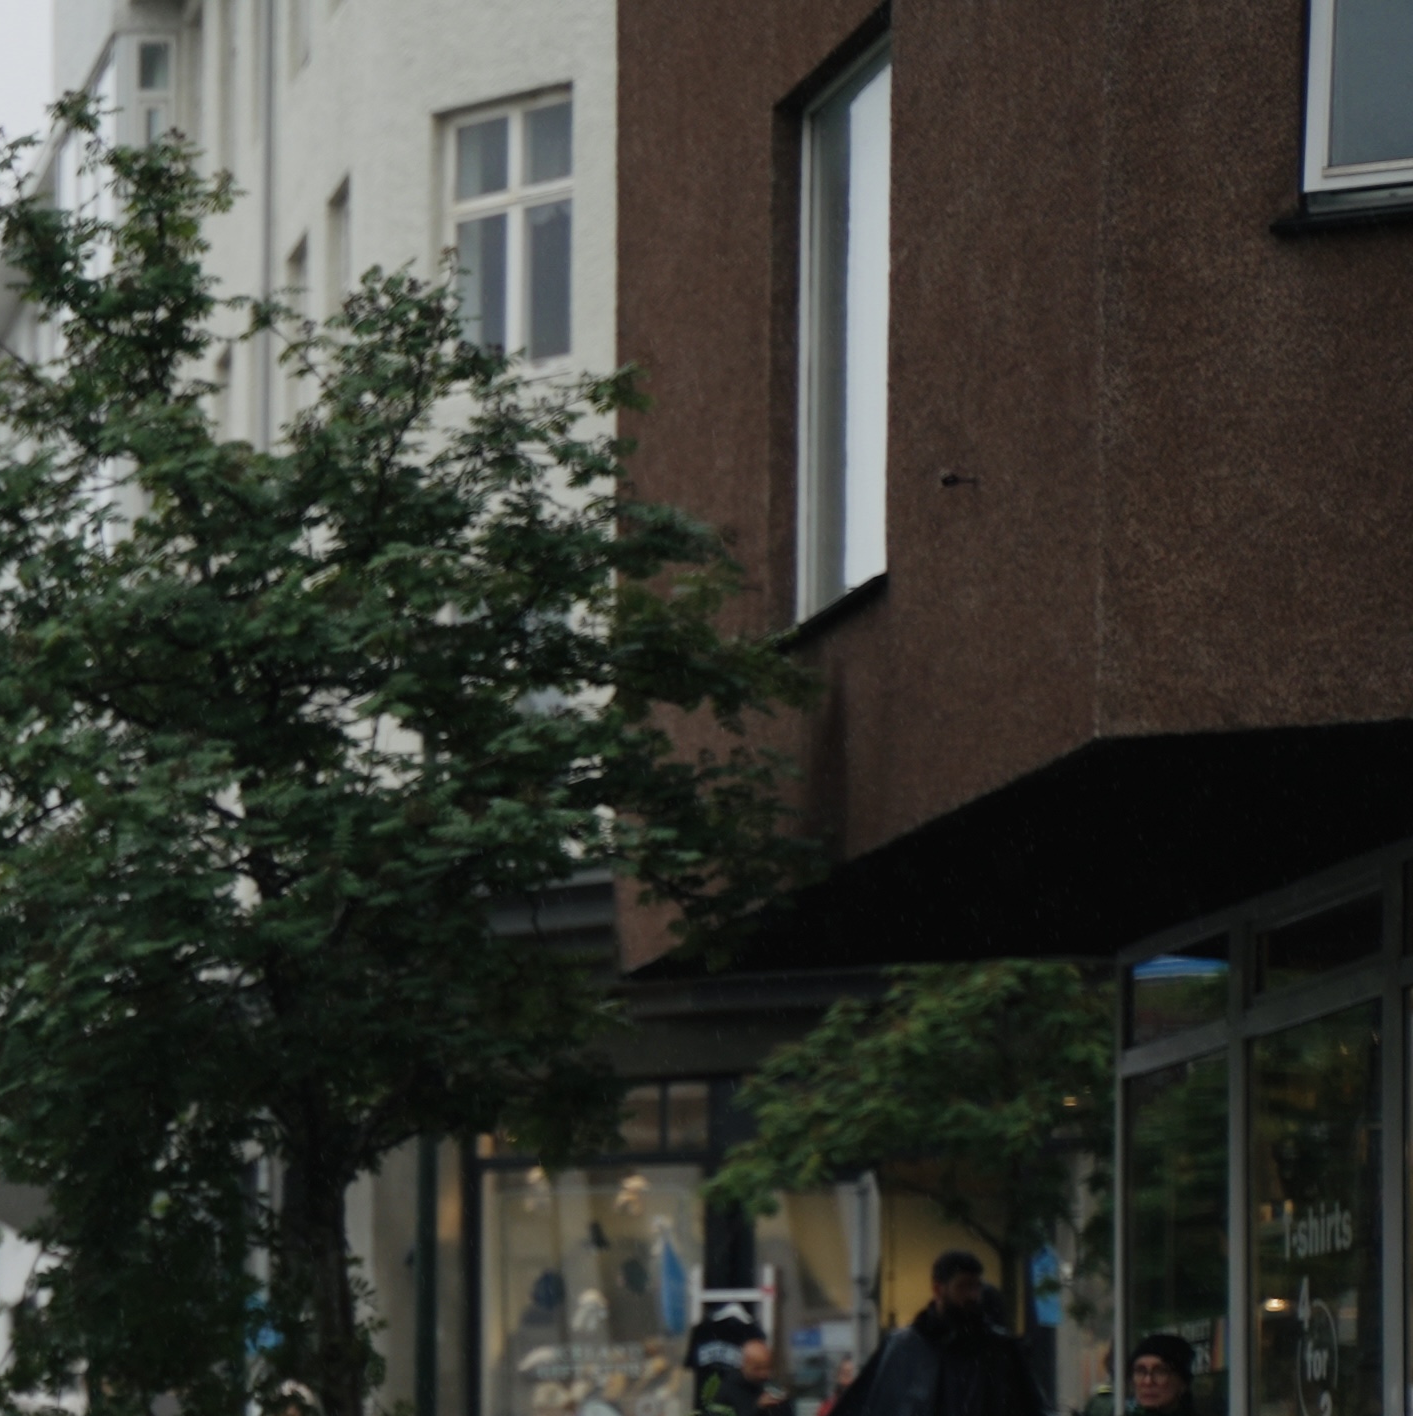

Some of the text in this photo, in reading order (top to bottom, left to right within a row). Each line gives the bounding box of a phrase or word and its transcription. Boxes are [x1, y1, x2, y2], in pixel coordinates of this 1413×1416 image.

[1283, 1200, 1354, 1262] T-shirts
[1297, 1275, 1311, 1332] 4
[1305, 1340, 1329, 1382] for
